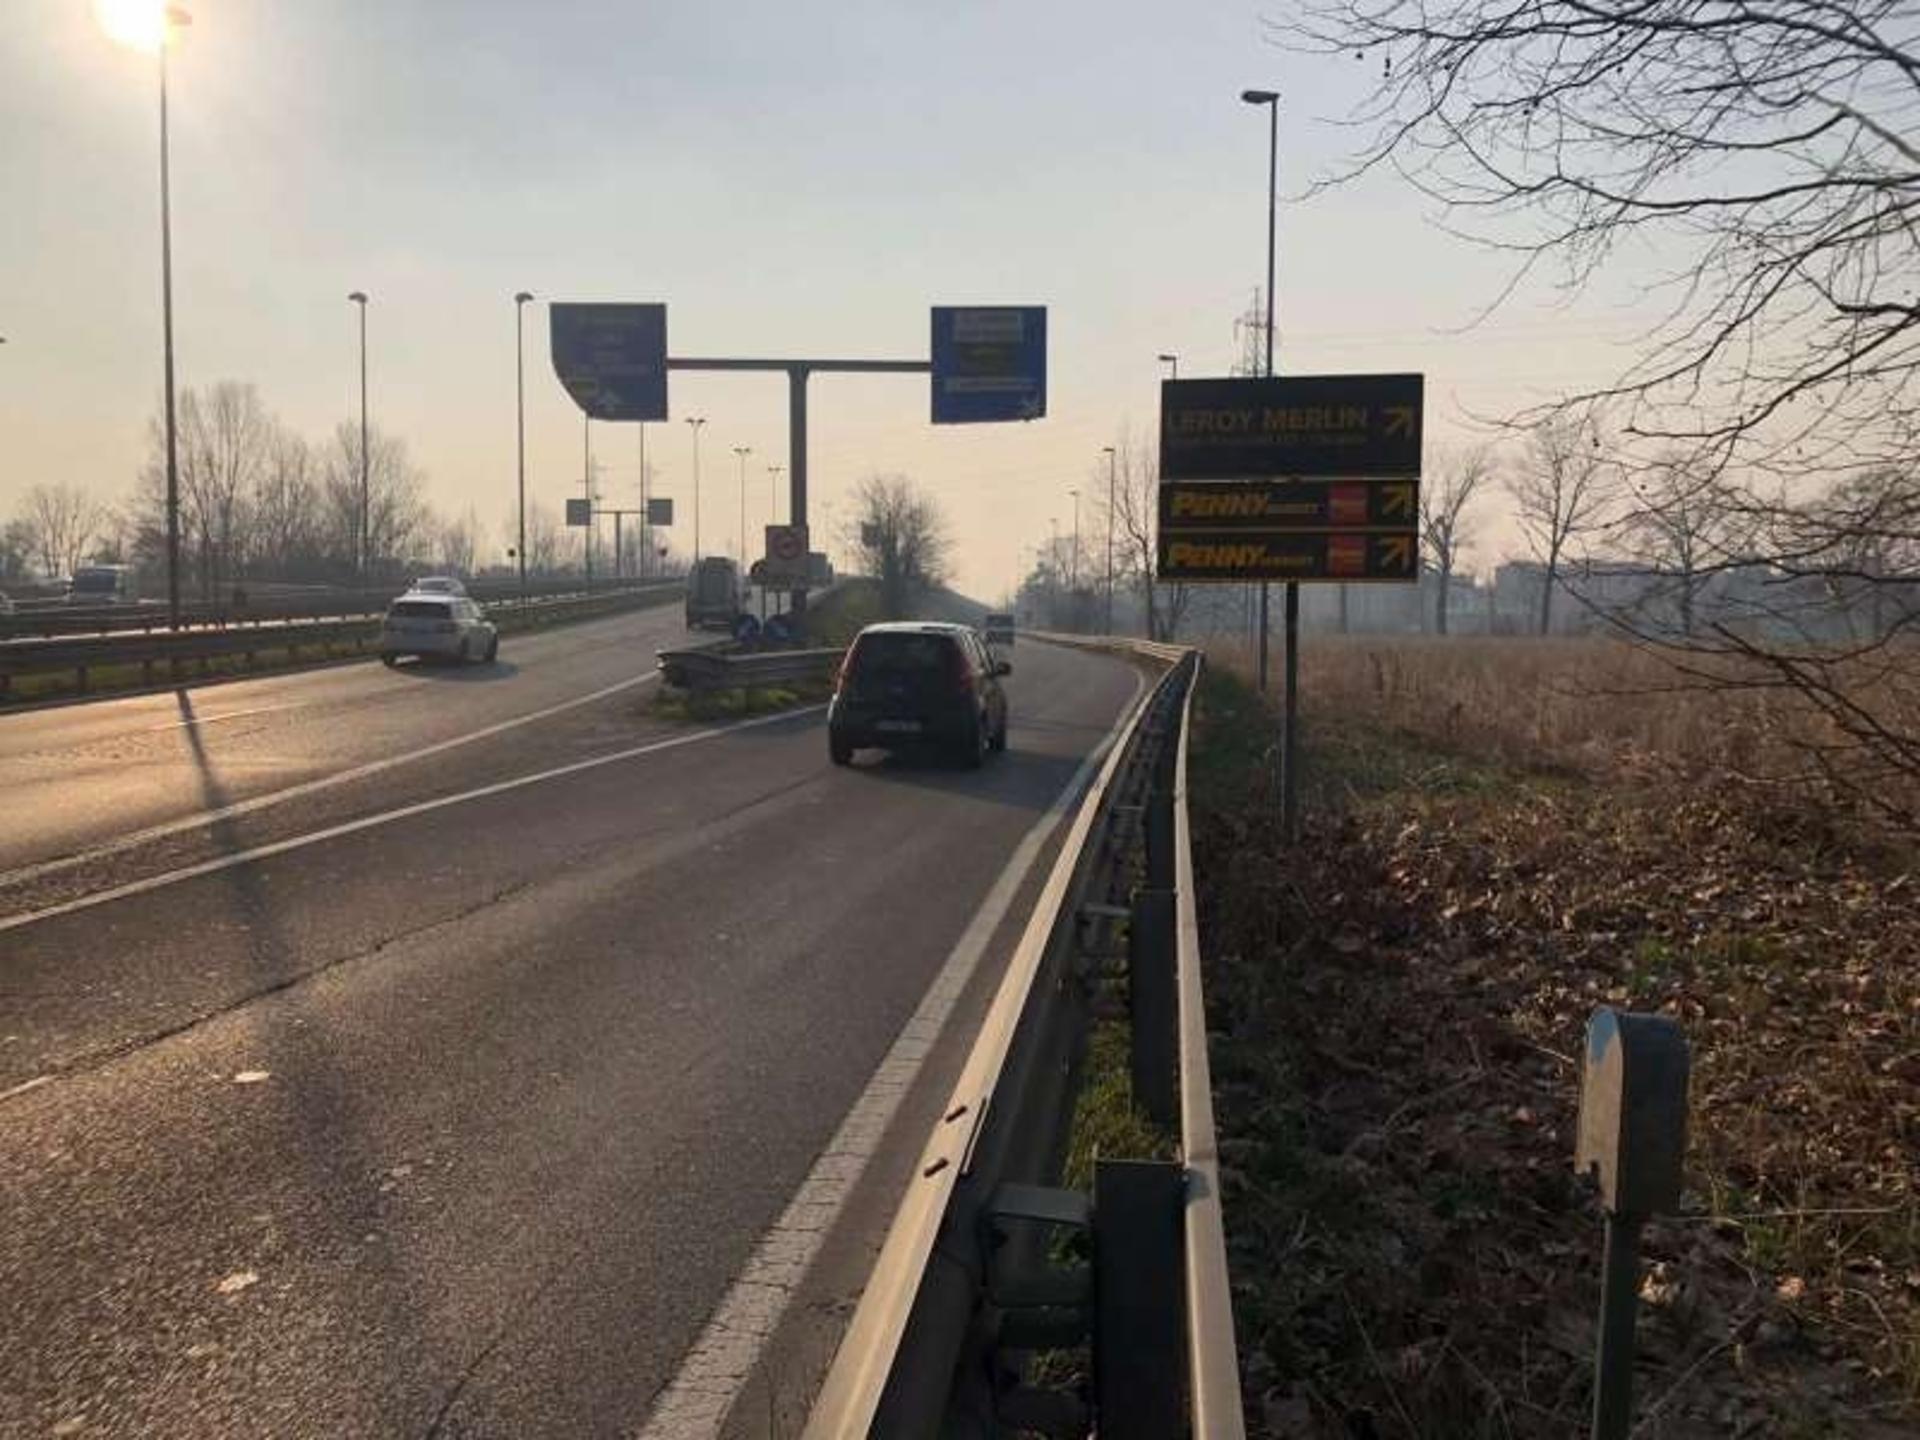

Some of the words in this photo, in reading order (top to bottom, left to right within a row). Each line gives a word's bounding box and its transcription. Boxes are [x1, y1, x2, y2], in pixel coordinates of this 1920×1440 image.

[1168, 408, 1253, 432] LEROY
[1264, 405, 1368, 432] MERLIN
[1170, 491, 1271, 517] PENNY
[1168, 542, 1268, 568] PENNY
